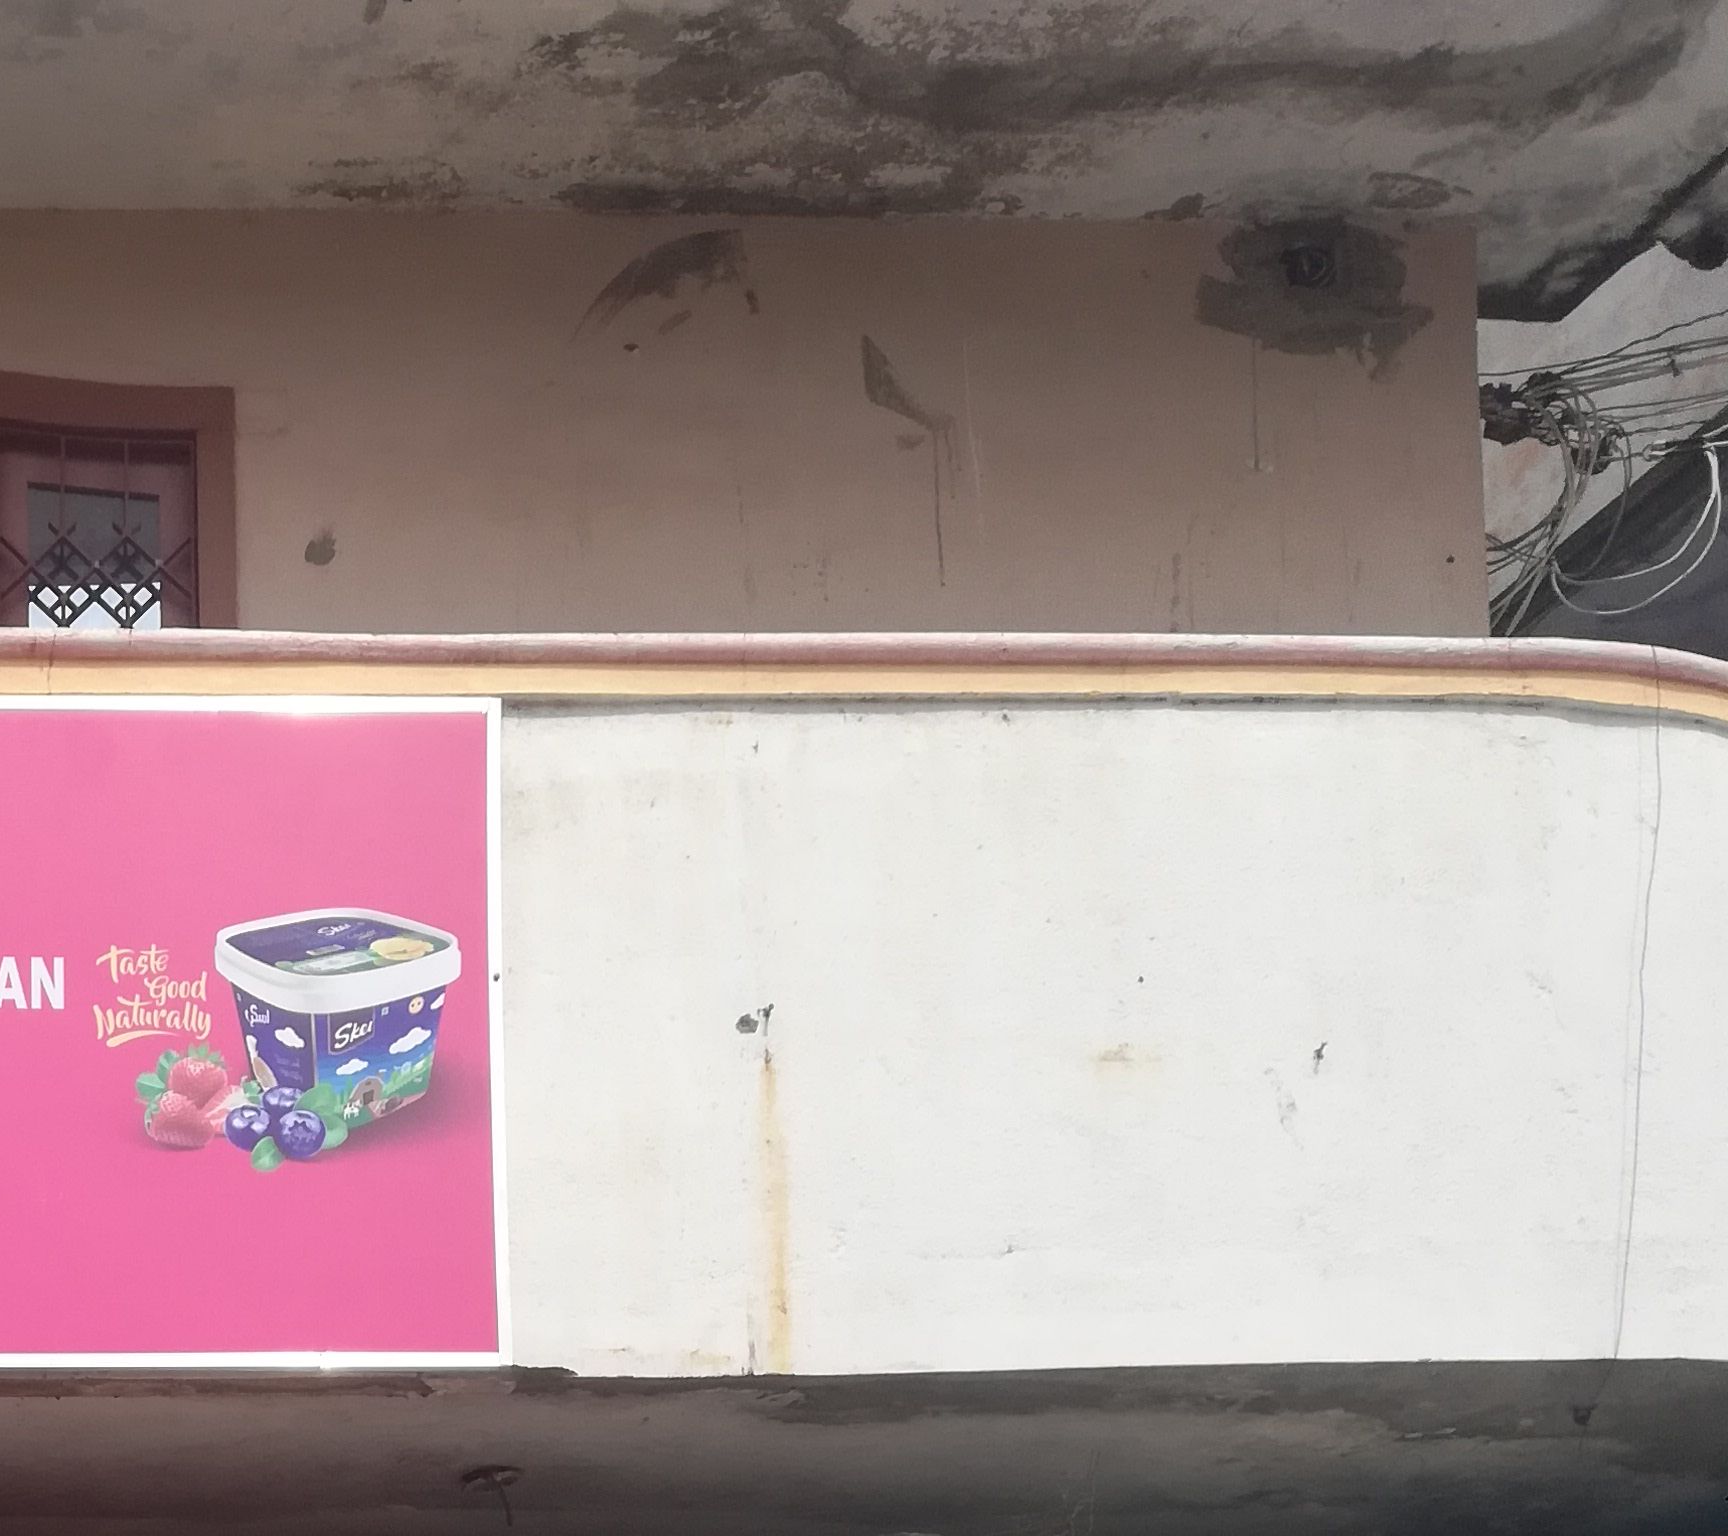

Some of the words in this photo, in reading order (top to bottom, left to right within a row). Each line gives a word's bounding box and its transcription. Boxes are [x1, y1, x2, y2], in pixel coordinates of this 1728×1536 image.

[95, 943, 170, 984] Taste
[143, 970, 208, 1006] Good
[92, 994, 211, 1040] Naturally
